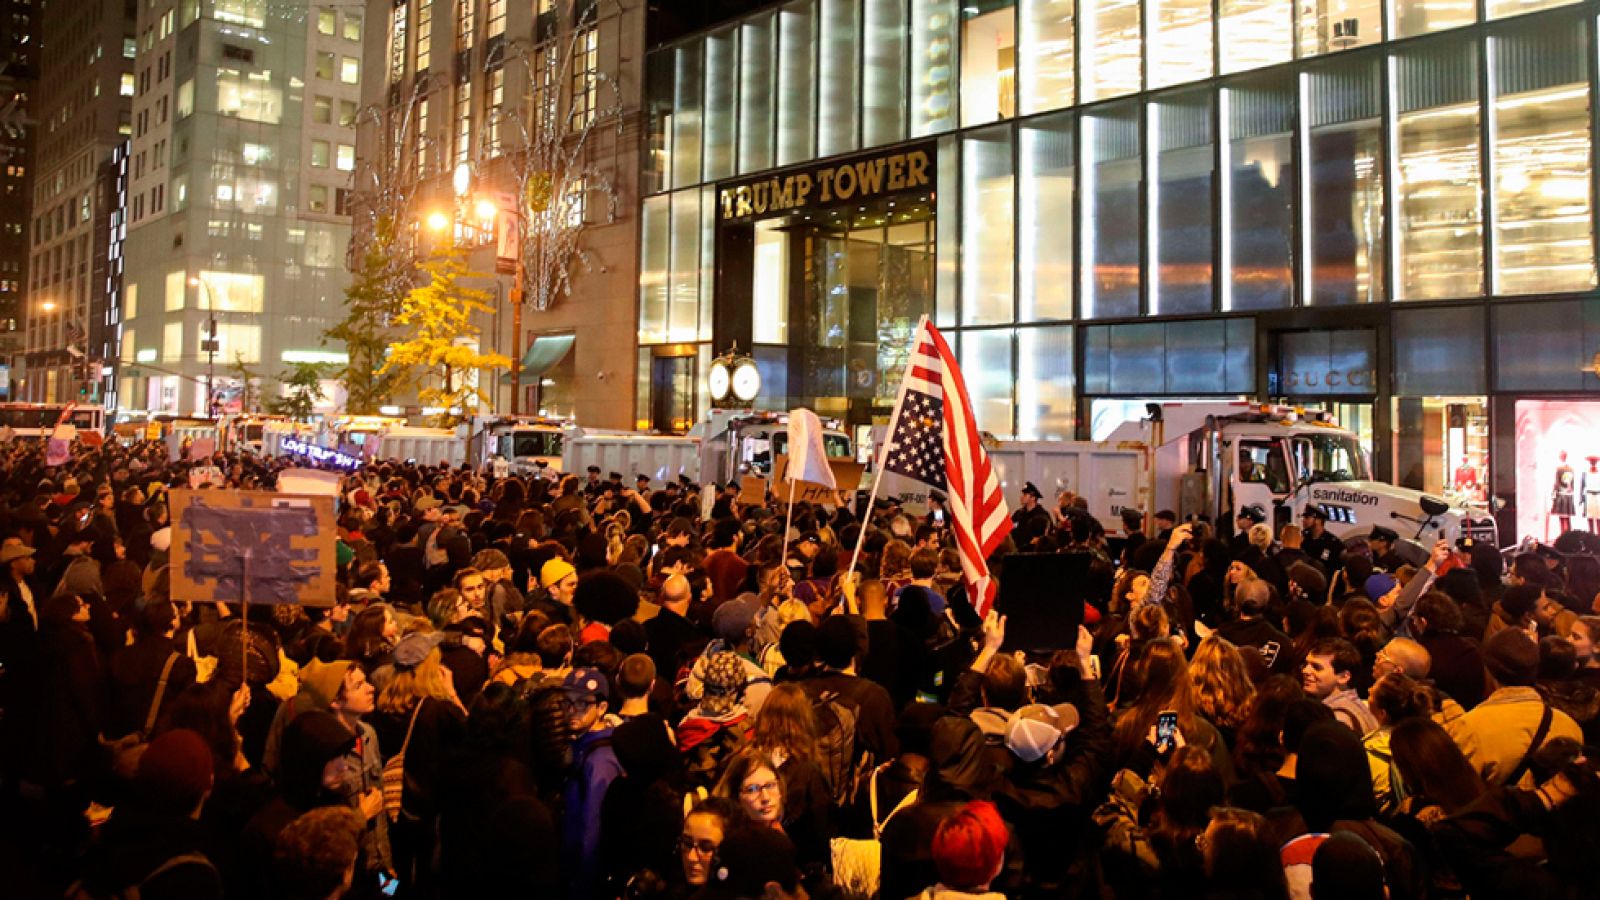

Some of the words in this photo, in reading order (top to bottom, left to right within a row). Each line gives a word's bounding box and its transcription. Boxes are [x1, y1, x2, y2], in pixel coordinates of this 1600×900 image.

[721, 174, 813, 219] TRUMP
[818, 150, 929, 201] TOWER
[1284, 369, 1377, 387] GUCCI
[1312, 487, 1379, 507] sanitation
